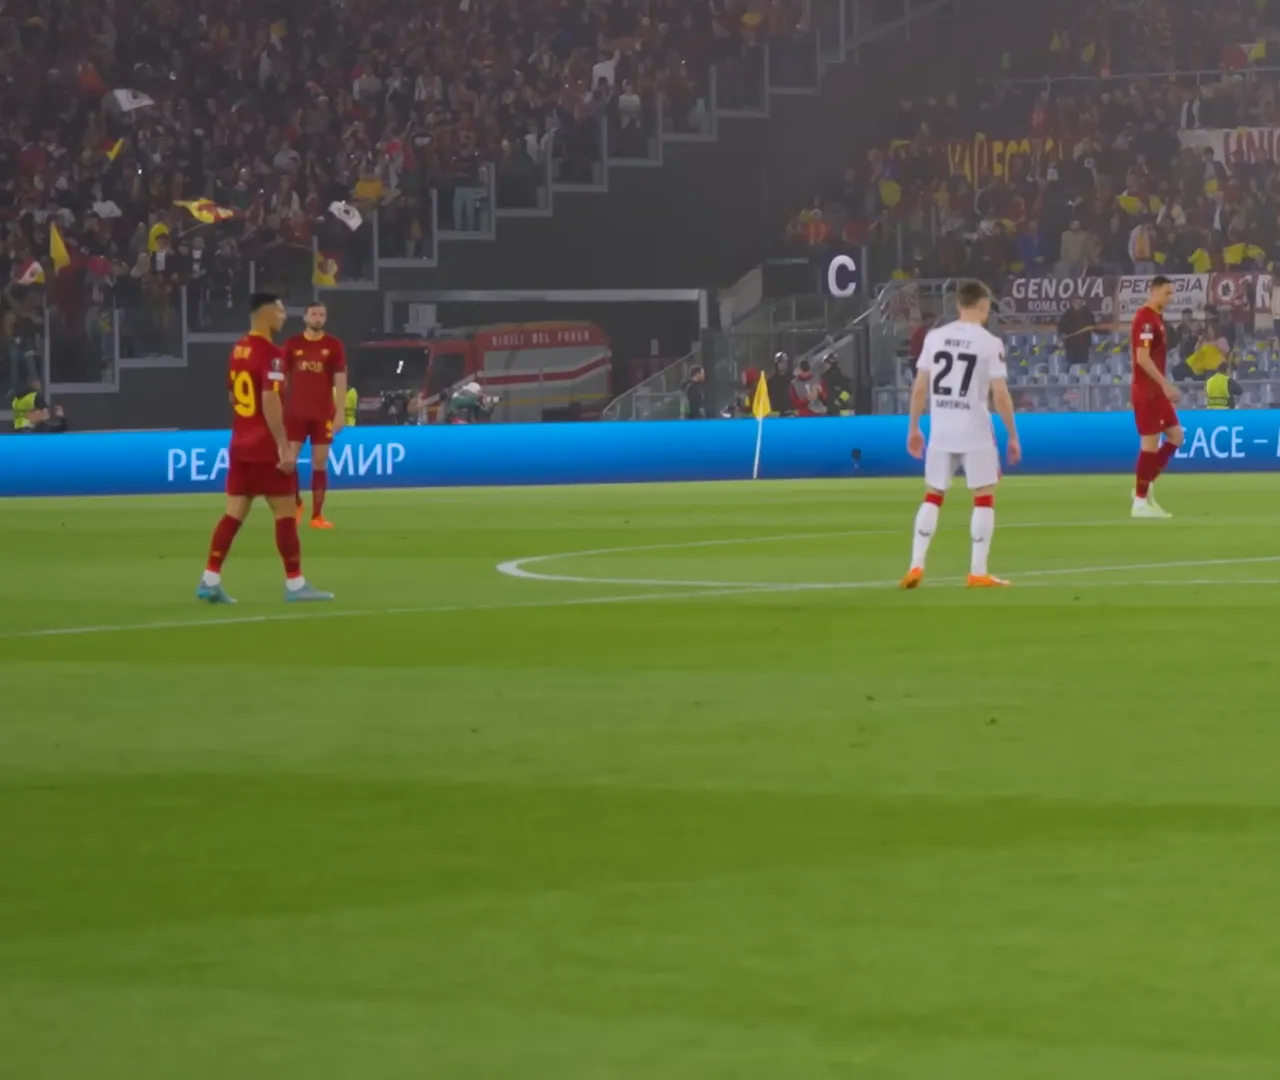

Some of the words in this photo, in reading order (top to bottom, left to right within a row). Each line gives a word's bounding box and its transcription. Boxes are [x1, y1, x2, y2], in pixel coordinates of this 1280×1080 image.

[827, 254, 857, 298] C
[1011, 277, 1105, 300] GENOVA
[1028, 300, 1058, 313] ROMA
[932, 350, 978, 398] 27
[230, 370, 256, 418] 9
[327, 441, 406, 476] МИР
